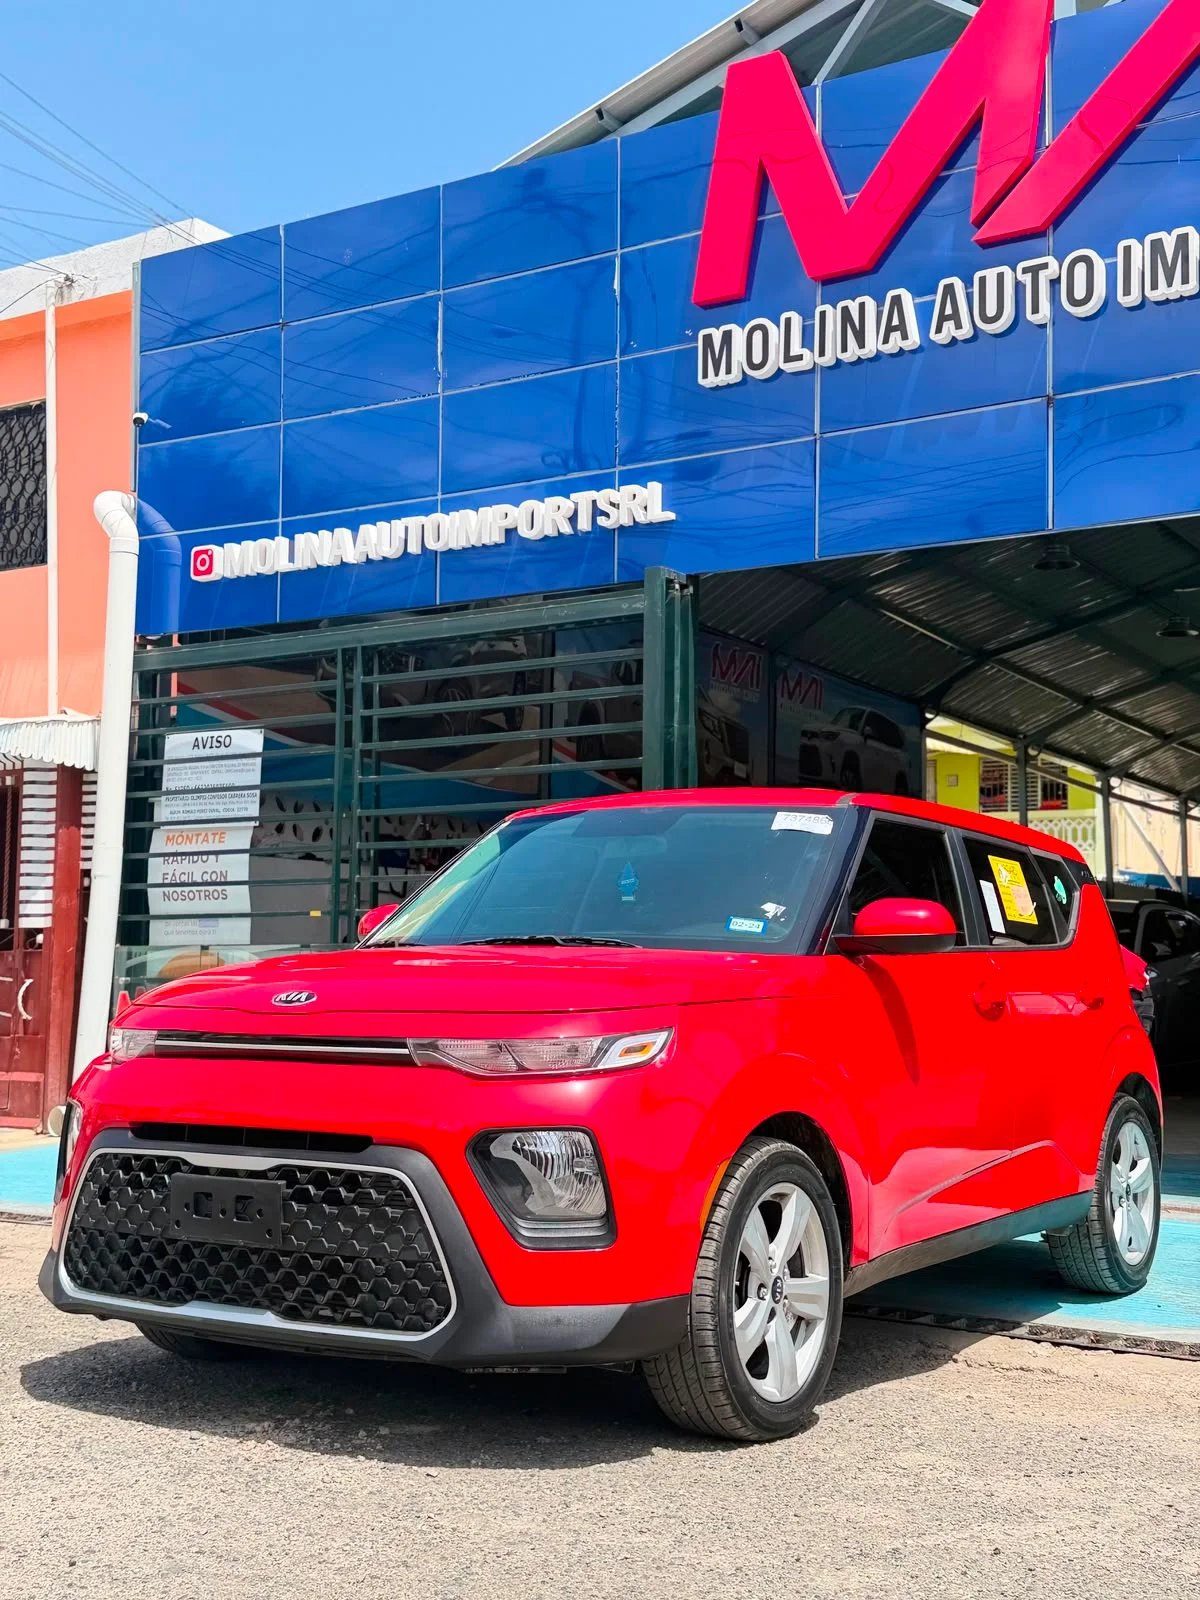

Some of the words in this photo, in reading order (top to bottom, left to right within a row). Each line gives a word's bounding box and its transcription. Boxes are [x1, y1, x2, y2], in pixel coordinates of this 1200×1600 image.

[697, 288, 920, 388] MOLINA
[929, 248, 1107, 345] AUTO
[1116, 226, 1200, 308] IM
[223, 481, 676, 579] MOLINAAUTOIMPORTSRL
[192, 734, 232, 750] AVISO
[165, 831, 227, 846] MÓNTATE
[162, 868, 198, 884] FÁCIL
[201, 870, 229, 883] CON
[162, 889, 228, 902] NOSOTROS
[274, 990, 311, 1003] KIA
[774, 1278, 783, 1302] KIA
